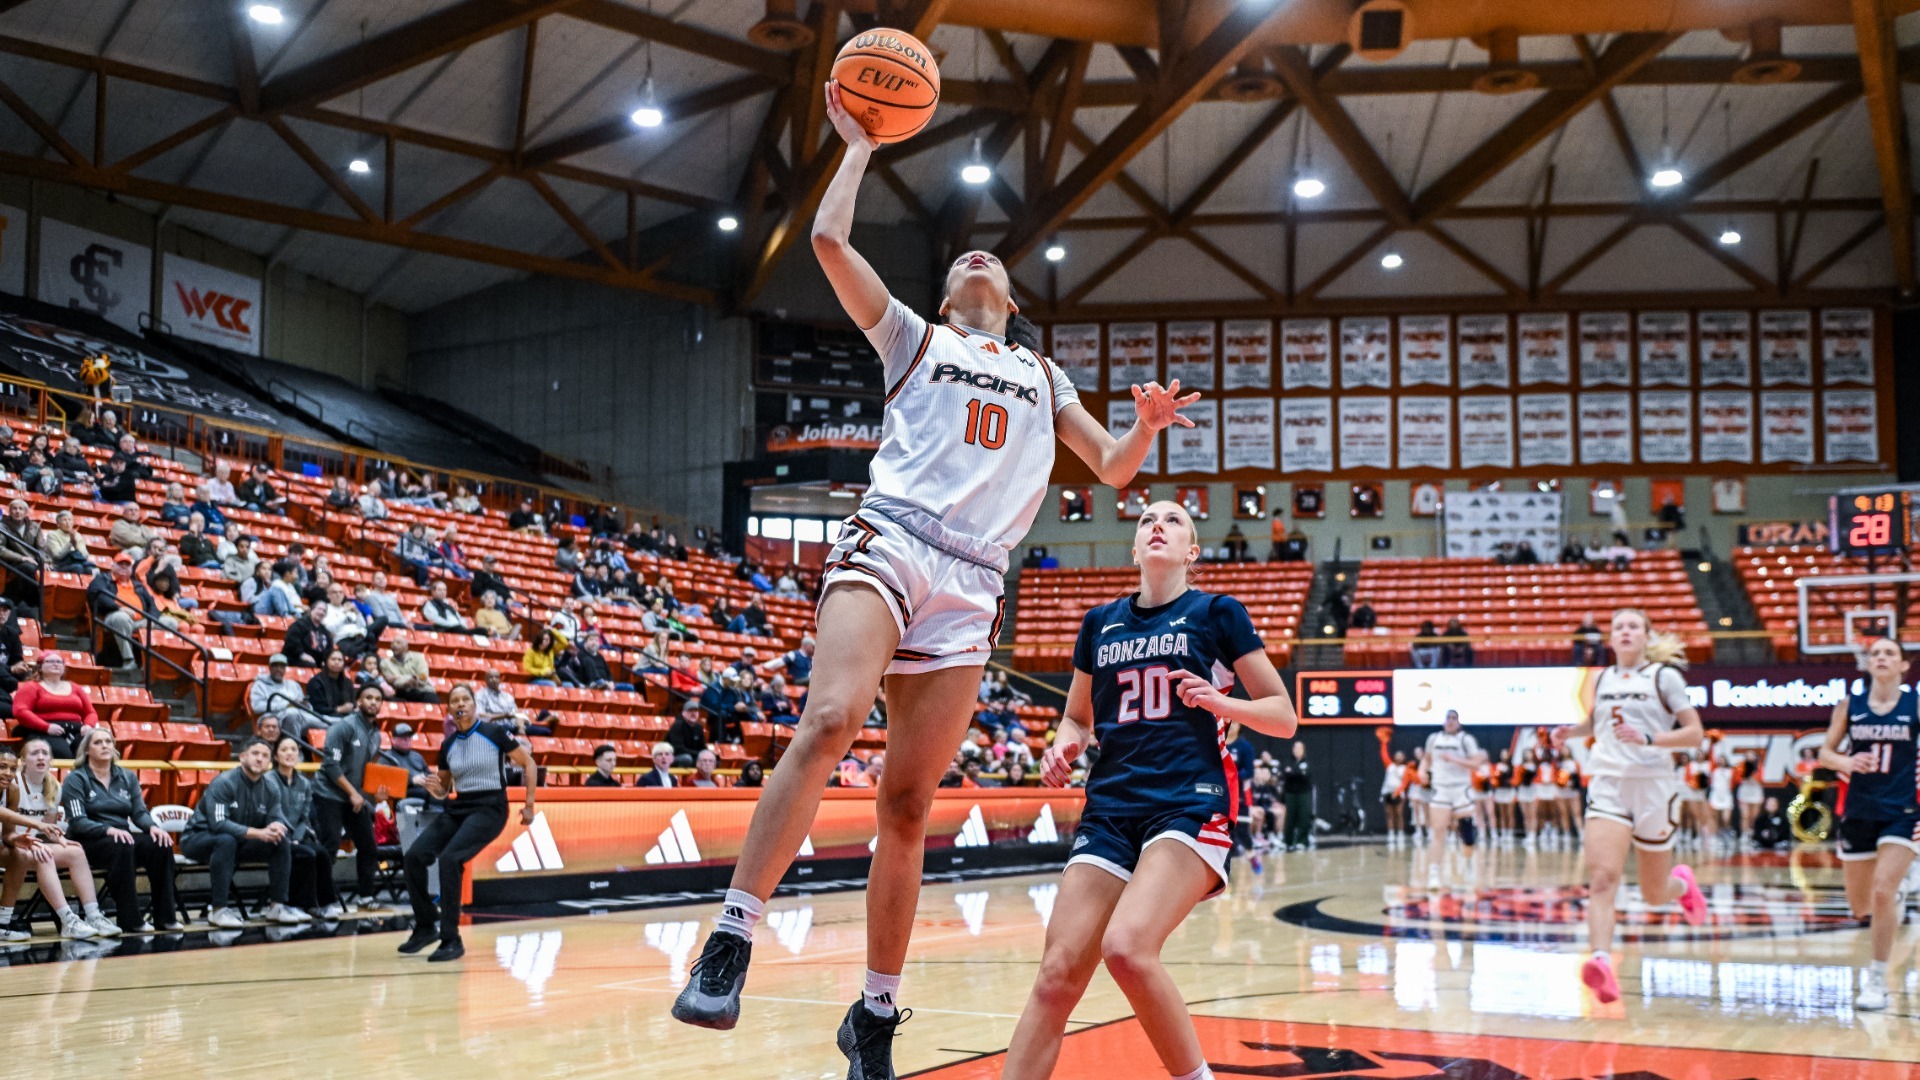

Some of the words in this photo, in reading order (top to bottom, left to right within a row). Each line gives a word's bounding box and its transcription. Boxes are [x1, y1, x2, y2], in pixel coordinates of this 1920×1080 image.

[855, 34, 927, 69] Wilson
[175, 279, 252, 334] WCC
[929, 362, 1039, 407] PACIFIC
[964, 398, 1009, 450] 10
[1850, 513, 1891, 546] 28
[1097, 633, 1188, 667] GONZAGA
[1117, 664, 1171, 724] 20
[1712, 678, 1847, 708] Basketball
[1611, 705, 1624, 727] 5
